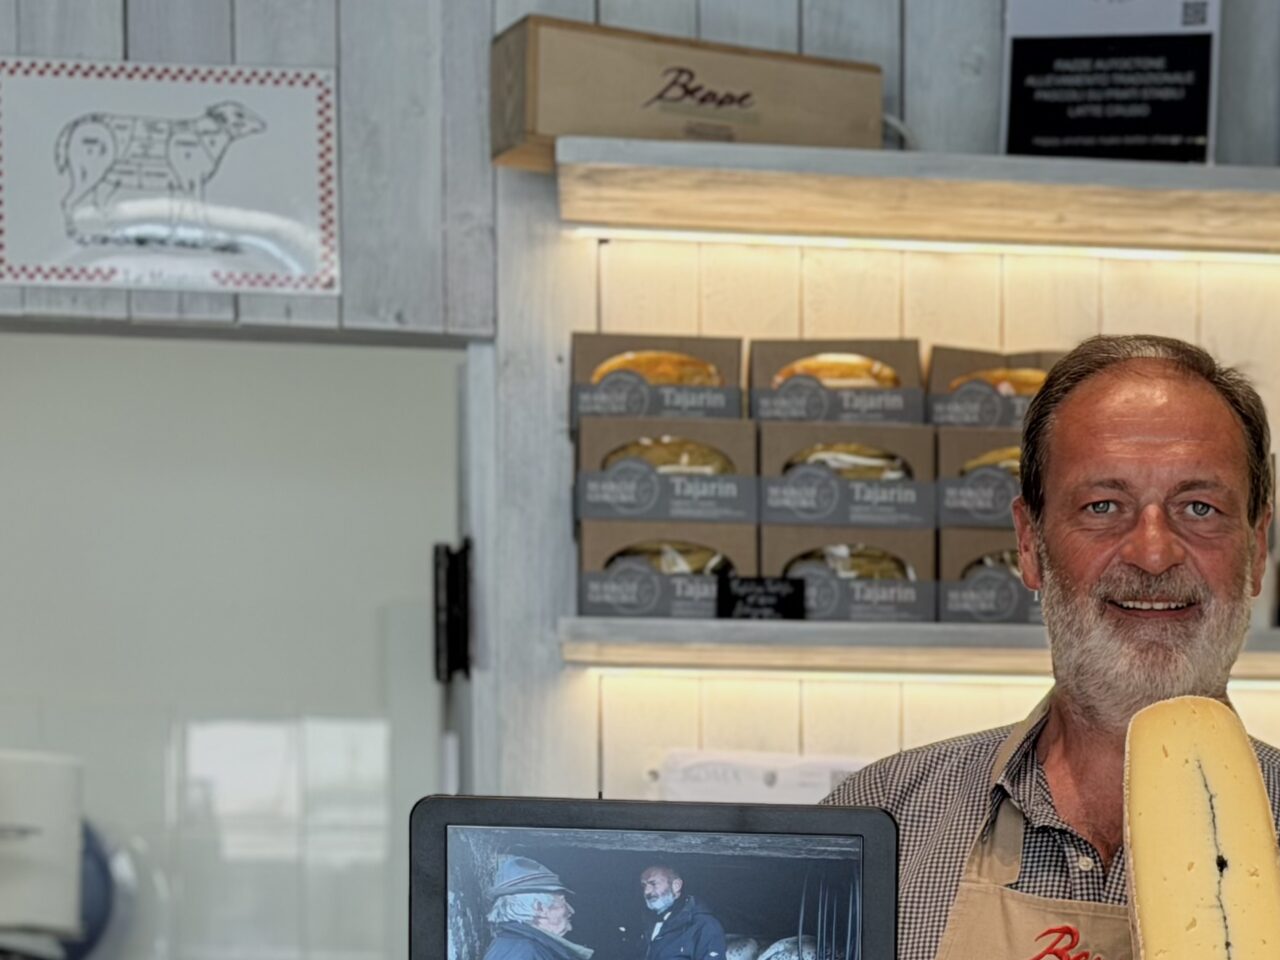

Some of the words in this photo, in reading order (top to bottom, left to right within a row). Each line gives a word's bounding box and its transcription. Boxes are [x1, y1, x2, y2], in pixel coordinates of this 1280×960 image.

[661, 387, 726, 409] Tajarin
[837, 390, 904, 412] Tajarin
[669, 476, 738, 500] Tajarin
[849, 481, 917, 504] Tajarin
[671, 578, 717, 601] Tajar
[850, 581, 917, 604] Tajarin
